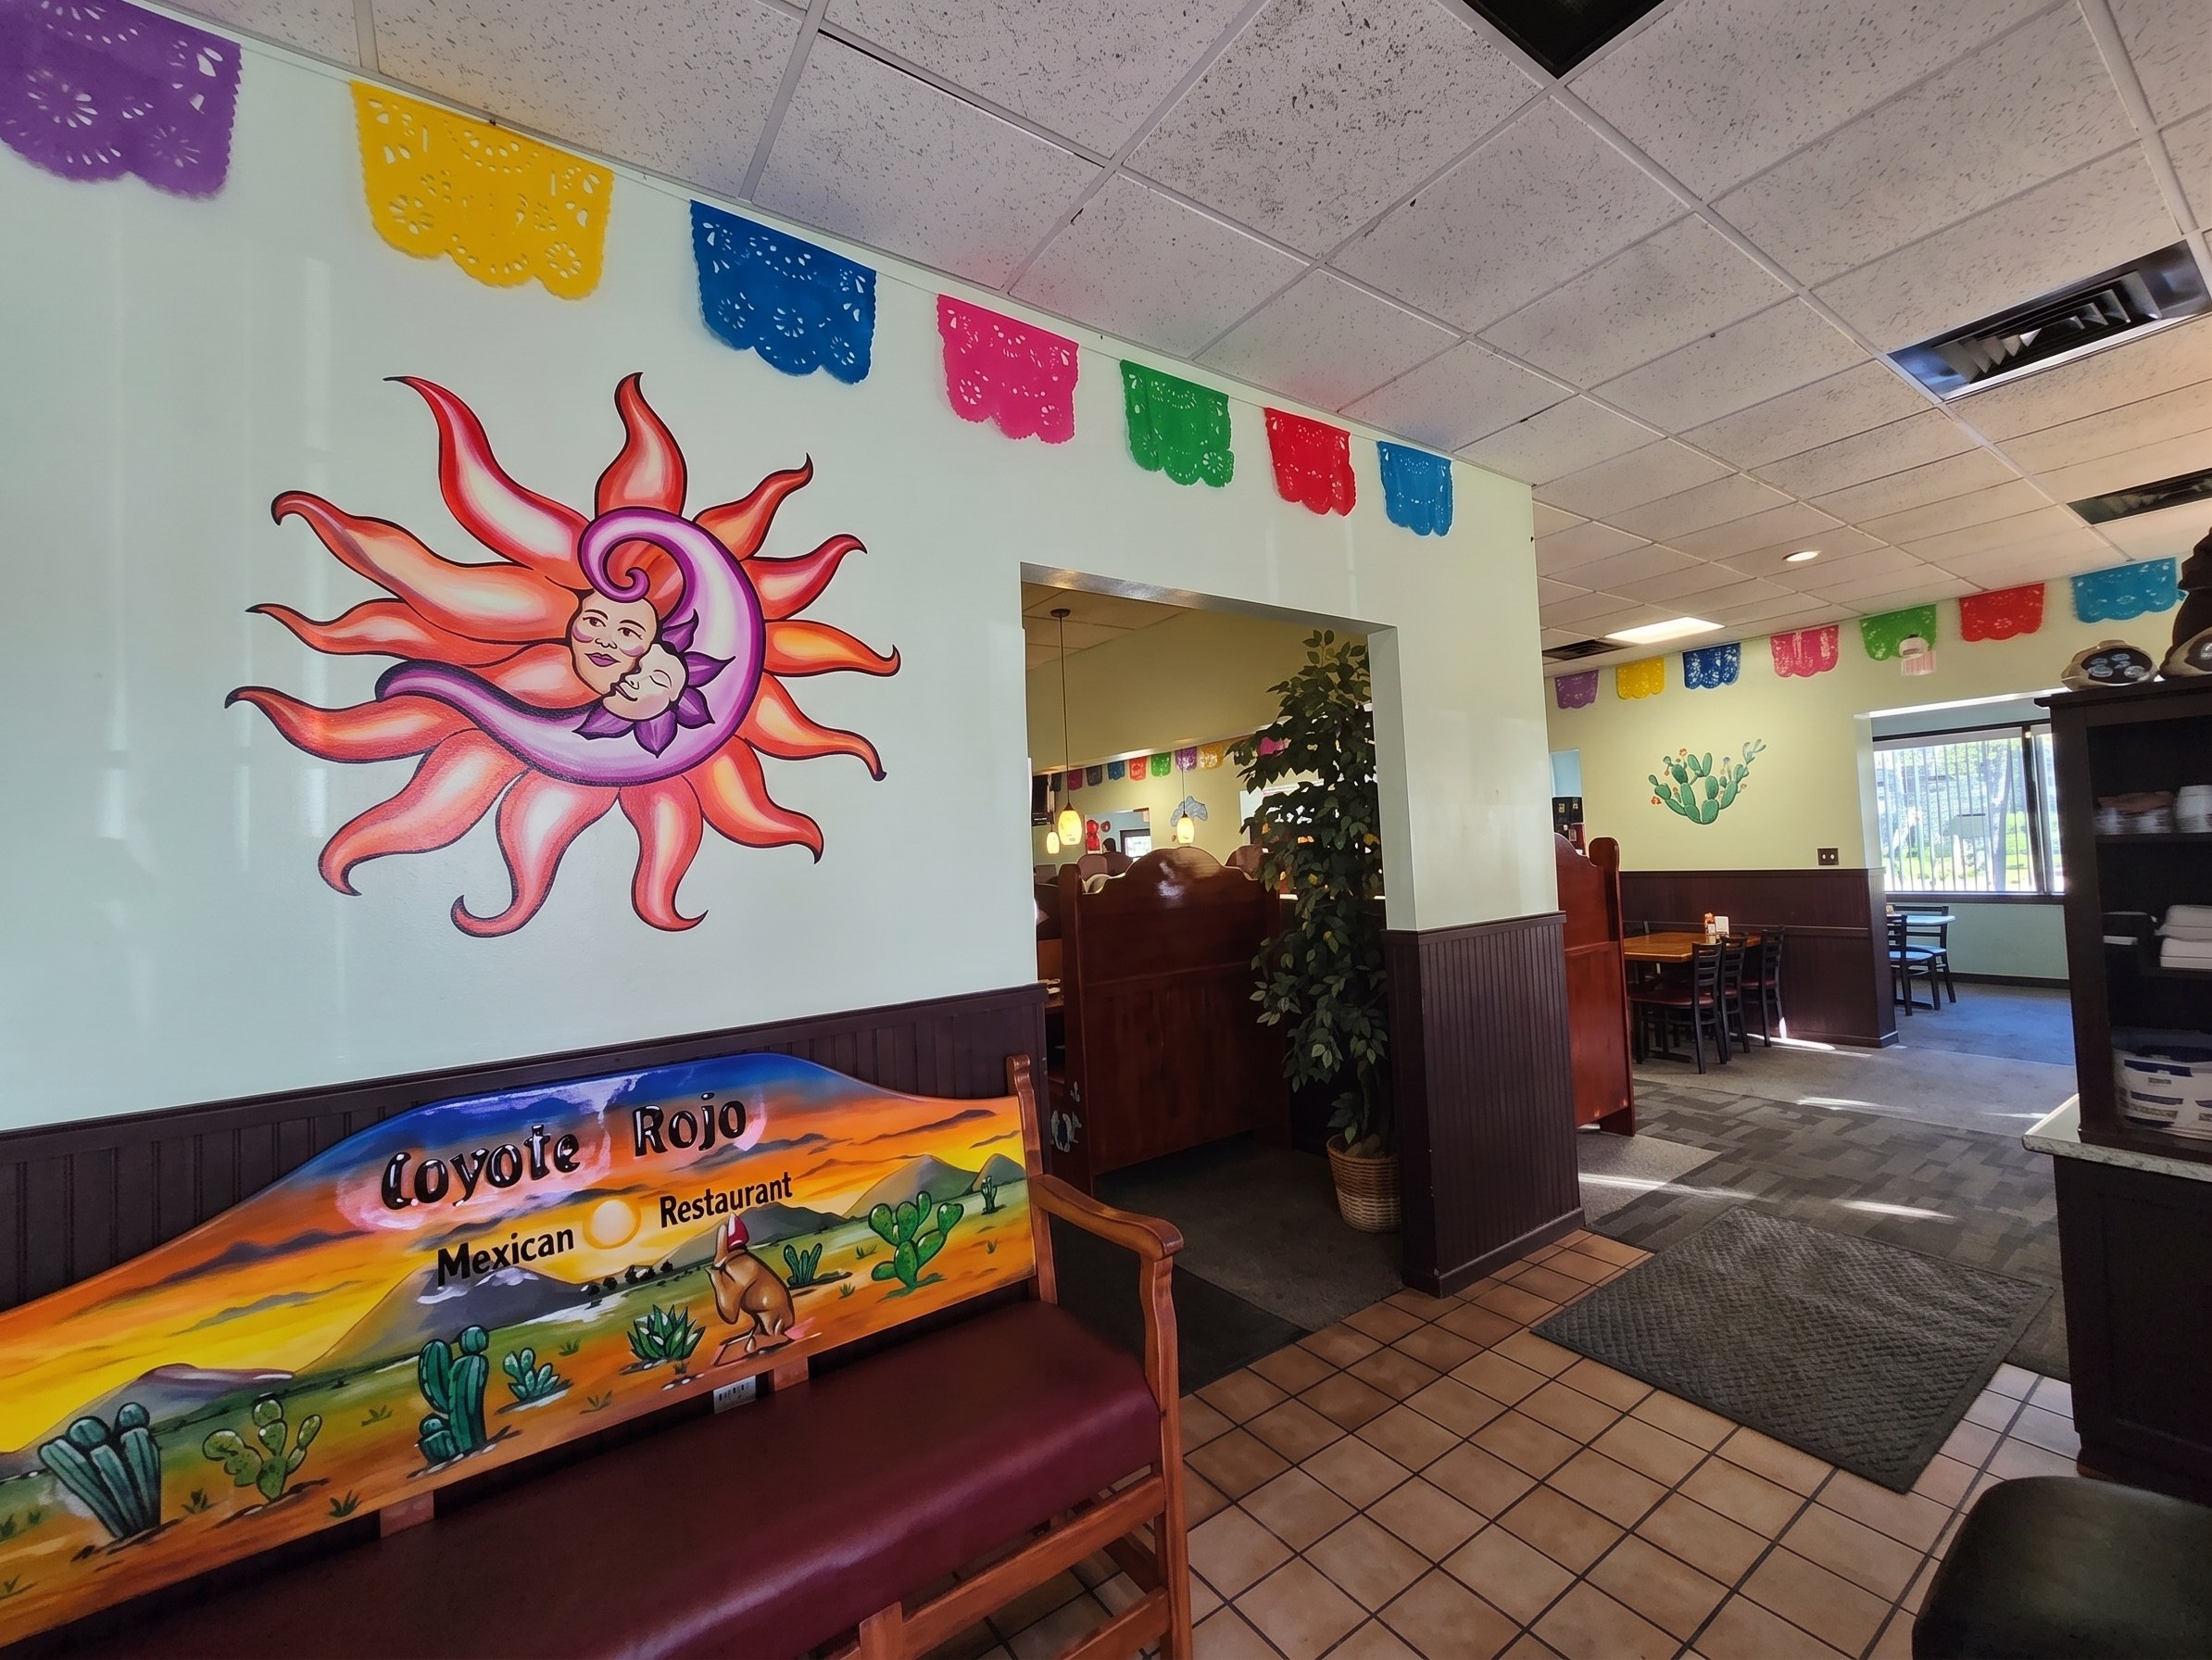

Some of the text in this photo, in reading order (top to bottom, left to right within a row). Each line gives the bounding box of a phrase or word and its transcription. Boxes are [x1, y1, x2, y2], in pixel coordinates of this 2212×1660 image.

[381, 1092, 748, 1211] Coyote Rojo
[437, 1171, 793, 1287] Mexican Restaurant
